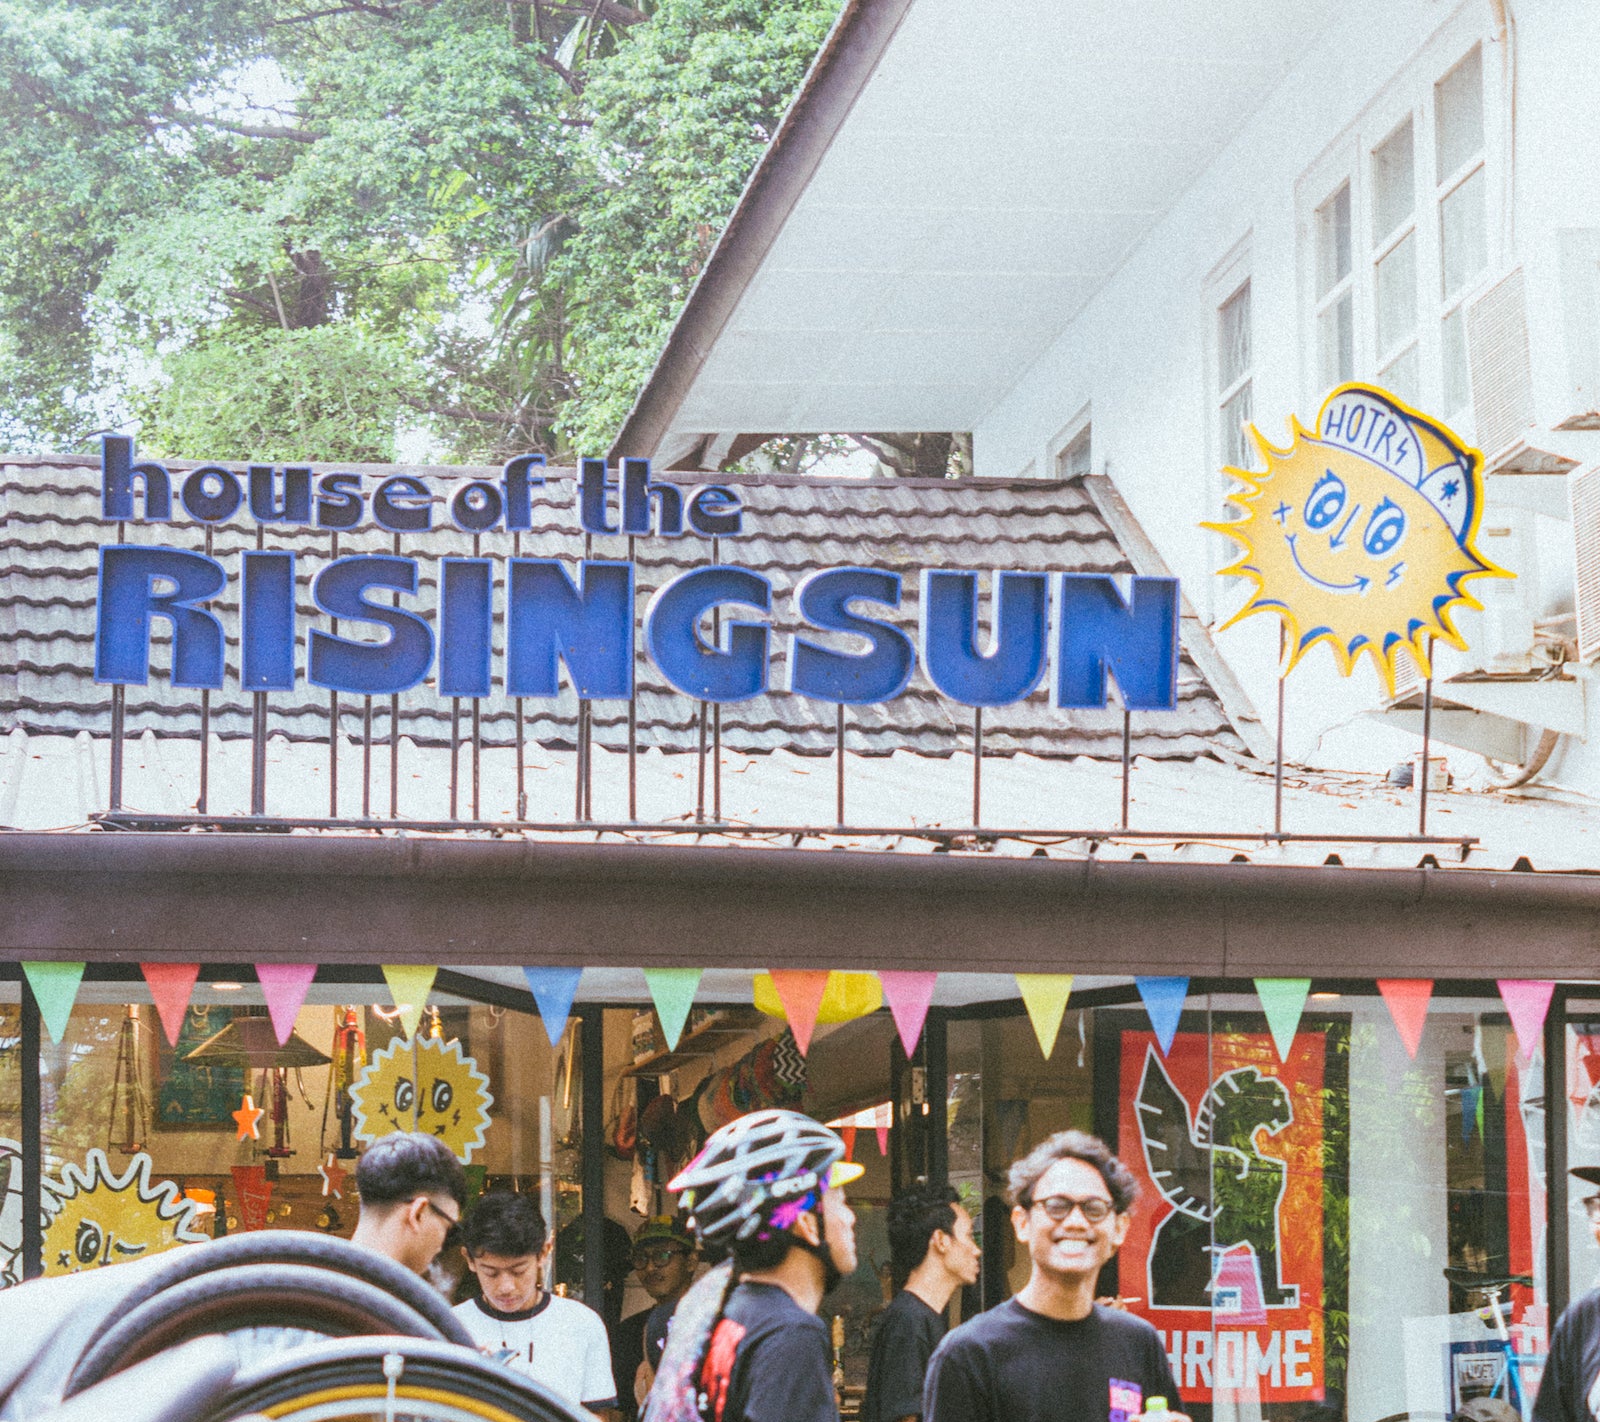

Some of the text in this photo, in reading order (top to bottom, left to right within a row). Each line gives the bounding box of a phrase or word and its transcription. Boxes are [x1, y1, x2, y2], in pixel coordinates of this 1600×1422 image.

[101, 434, 744, 537] house of the
[1158, 1330, 1313, 1388] HROME
